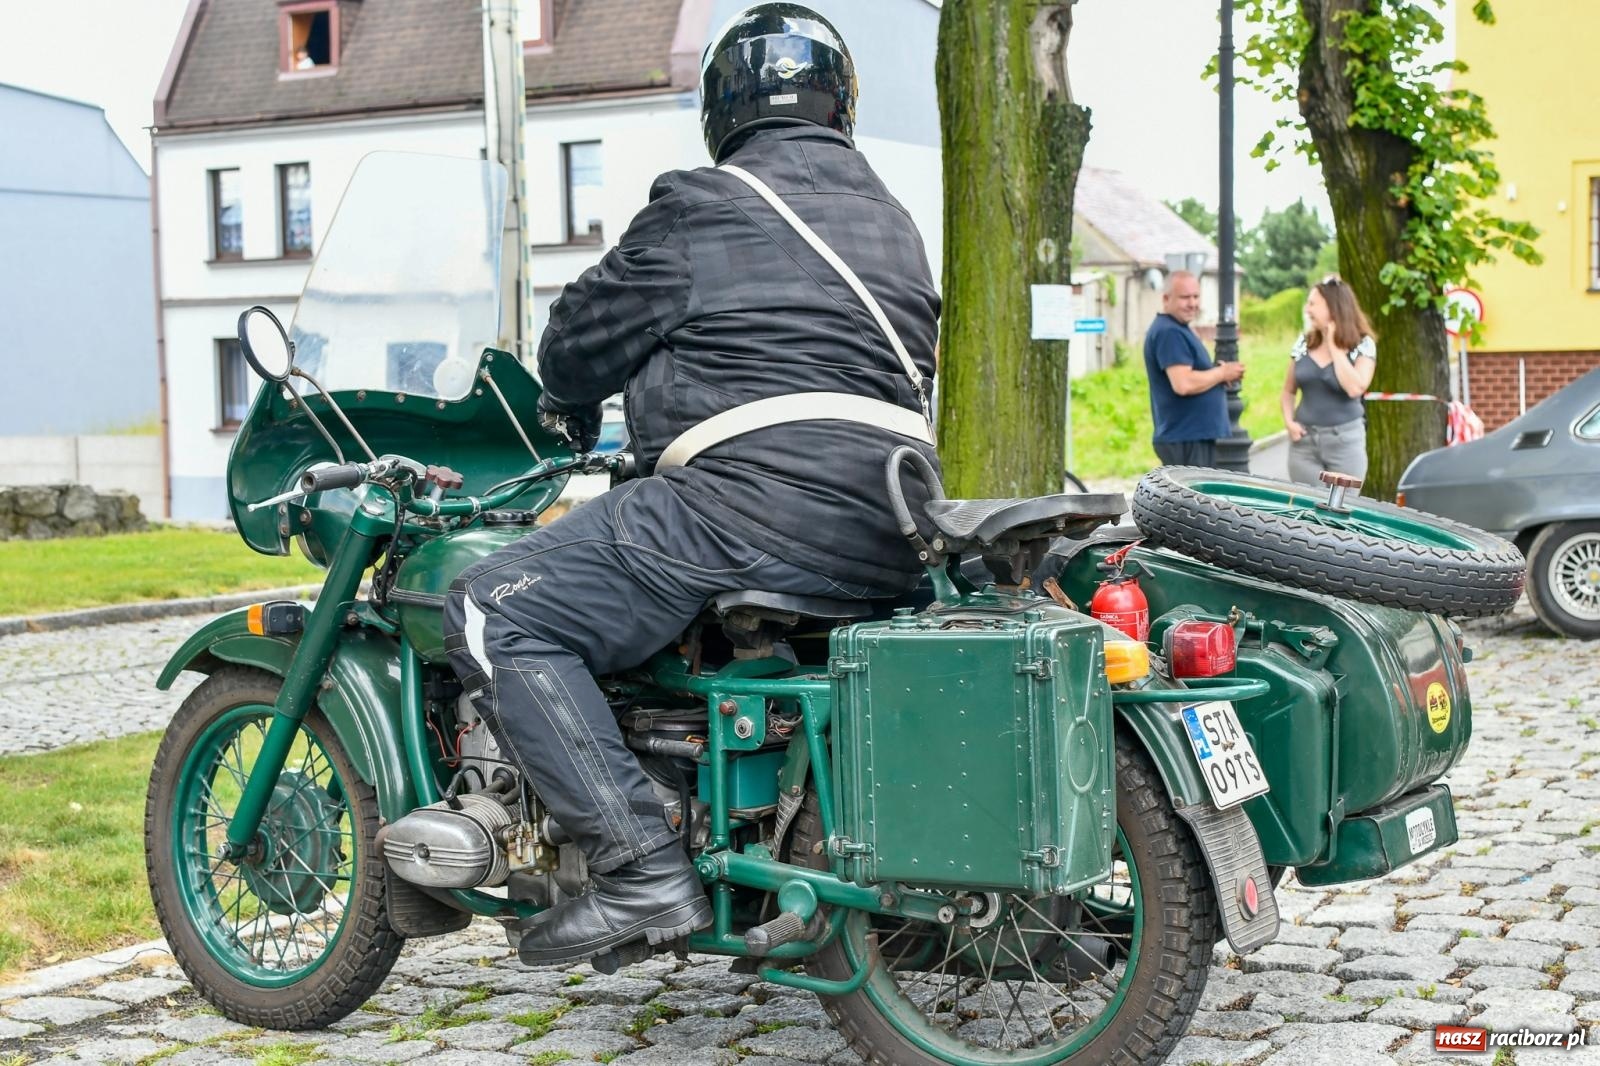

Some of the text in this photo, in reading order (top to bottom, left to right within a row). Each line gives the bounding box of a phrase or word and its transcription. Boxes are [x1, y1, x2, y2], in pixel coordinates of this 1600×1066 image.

[1194, 738, 1210, 754] PL
[1203, 709, 1239, 746] STA
[1211, 751, 1261, 794] 09TS
